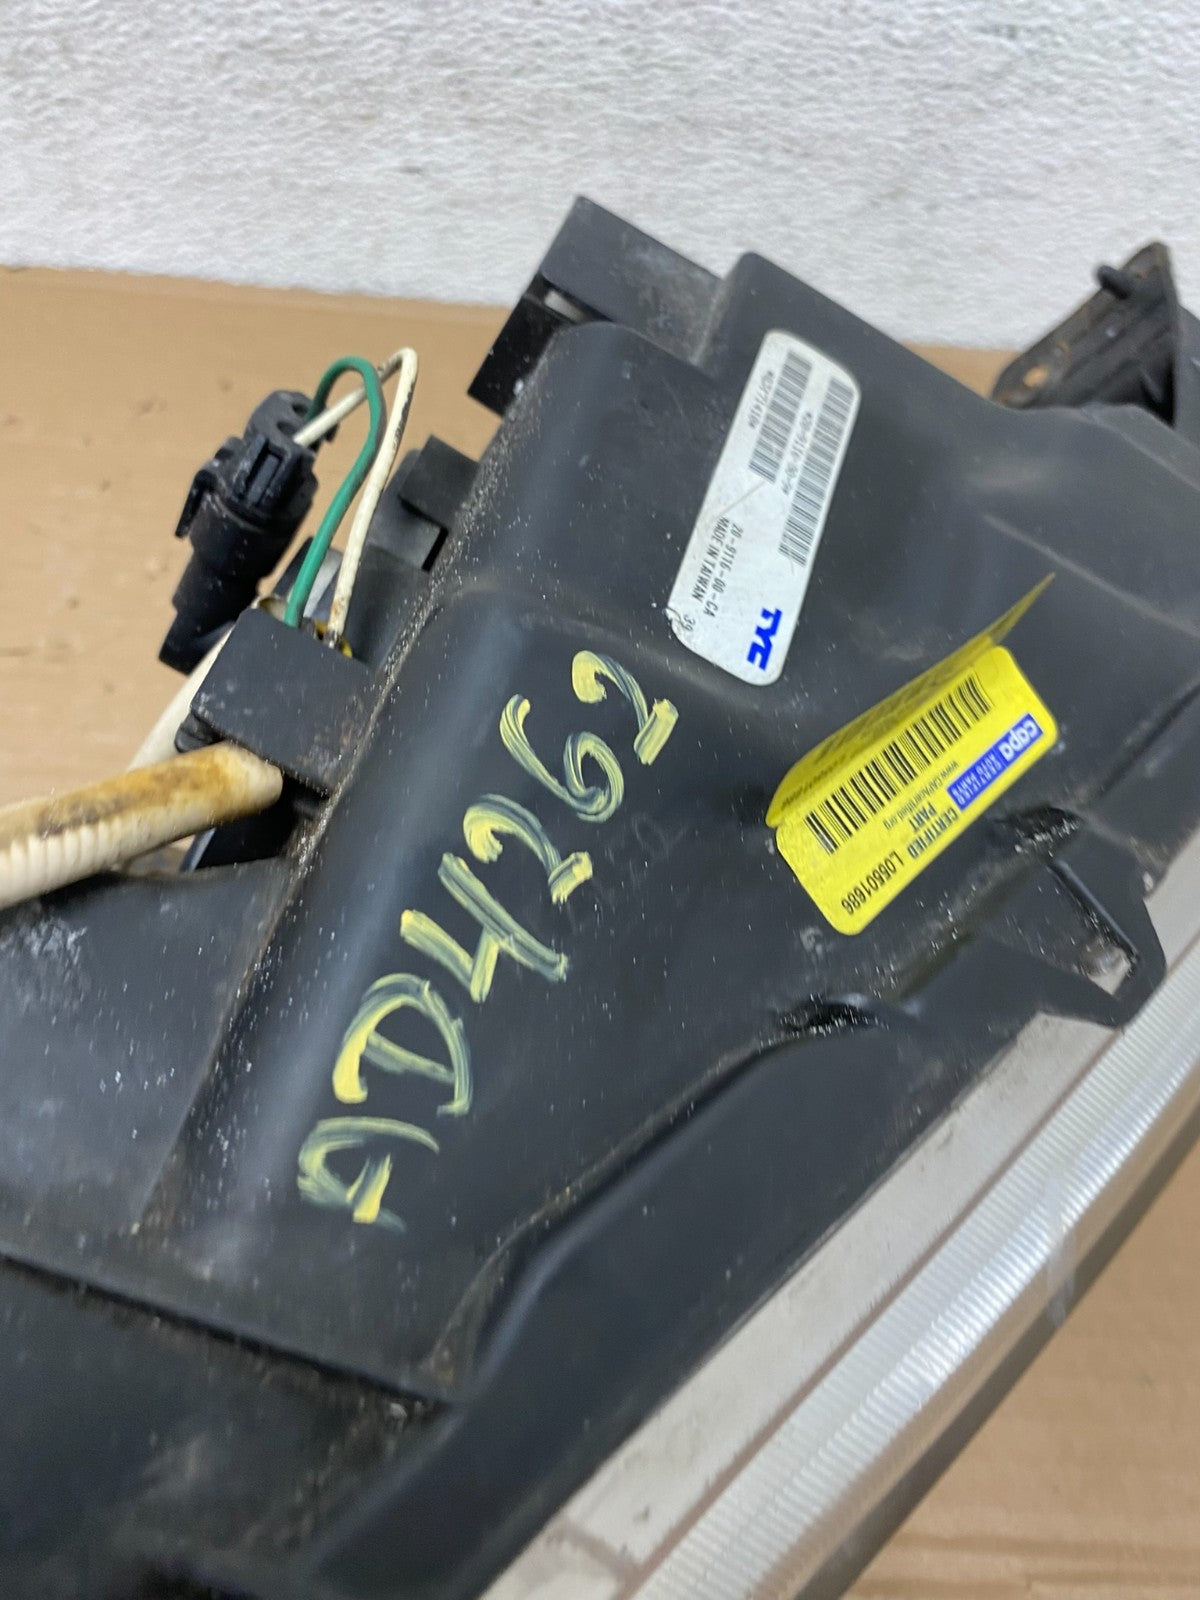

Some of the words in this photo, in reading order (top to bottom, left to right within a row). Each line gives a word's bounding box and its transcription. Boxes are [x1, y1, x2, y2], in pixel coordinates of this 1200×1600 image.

[706, 543, 720, 560] IN
[711, 516, 730, 543] MADE
[691, 559, 716, 603] TAIWAN
[747, 608, 783, 670] TYC
[996, 715, 1041, 762] capa
[905, 806, 960, 860] CERTIFIED
[907, 801, 938, 834] PART
[297, 650, 679, 1231] AD4262
